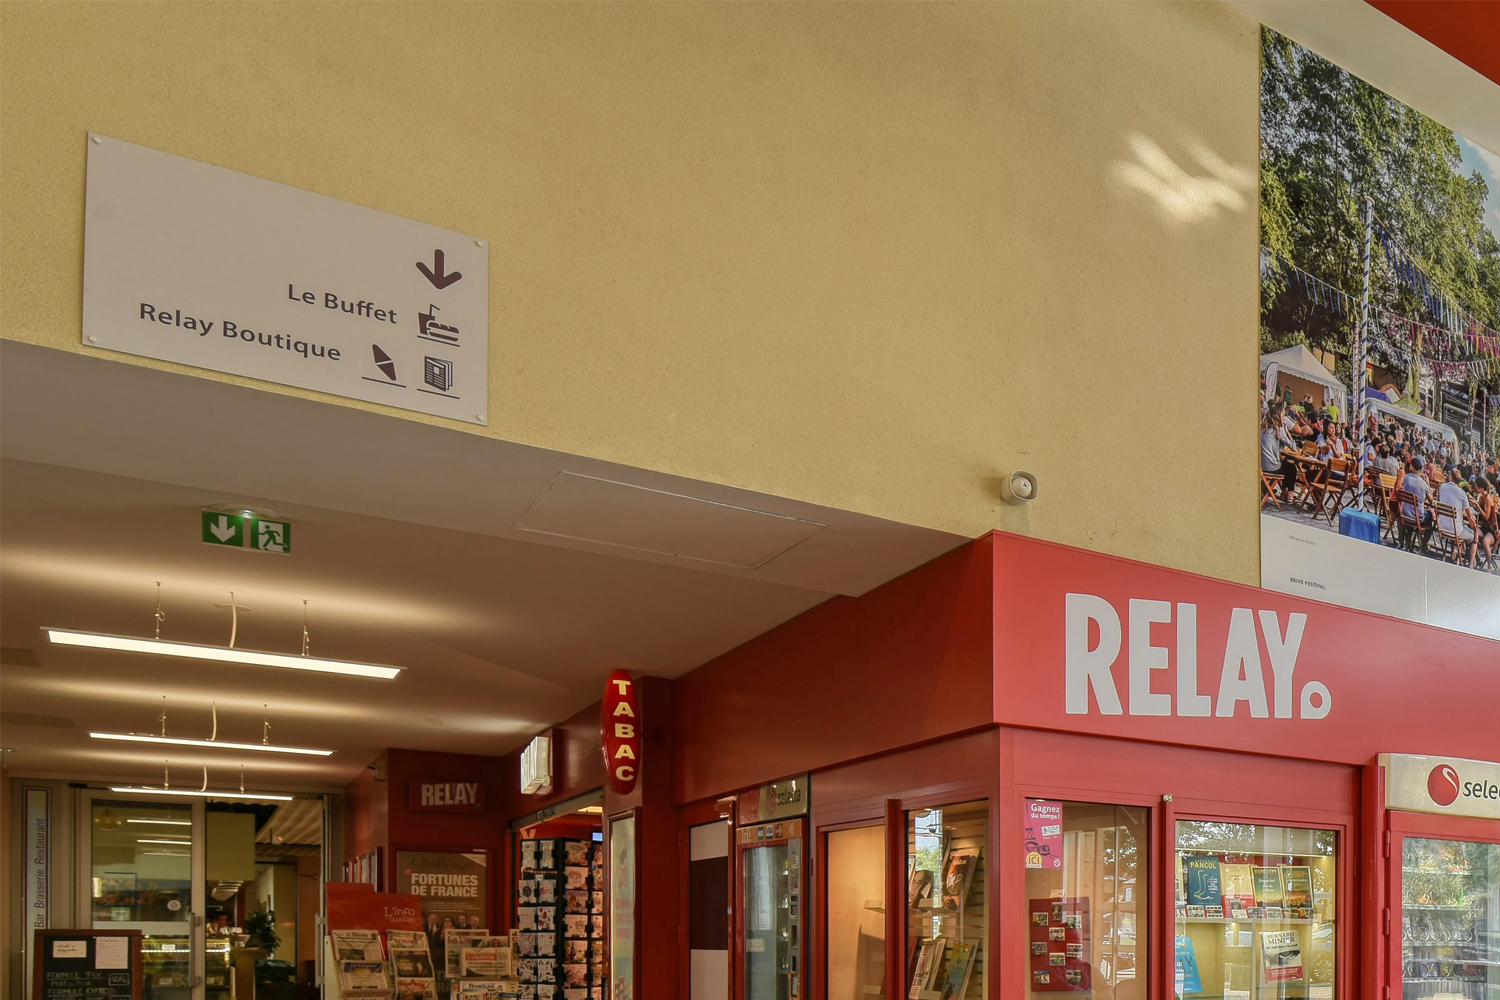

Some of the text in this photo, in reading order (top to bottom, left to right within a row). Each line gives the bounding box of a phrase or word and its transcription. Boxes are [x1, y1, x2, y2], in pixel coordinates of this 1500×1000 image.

[287, 283, 397, 324] Le Buffet
[140, 302, 341, 361] Relay Boutique
[1290, 577, 1326, 590] BRIVE FESTIVAL
[1065, 592, 1309, 719] RELAY
[613, 680, 635, 781] TABAC
[421, 783, 478, 806] RELAY
[1031, 804, 1060, 814] Gagnez
[34, 818, 45, 864] Restaurant
[34, 869, 45, 908] Brasserie
[411, 873, 478, 886] FORTUNES
[411, 885, 478, 897] DE FRANCE
[34, 914, 45, 928] Bar
